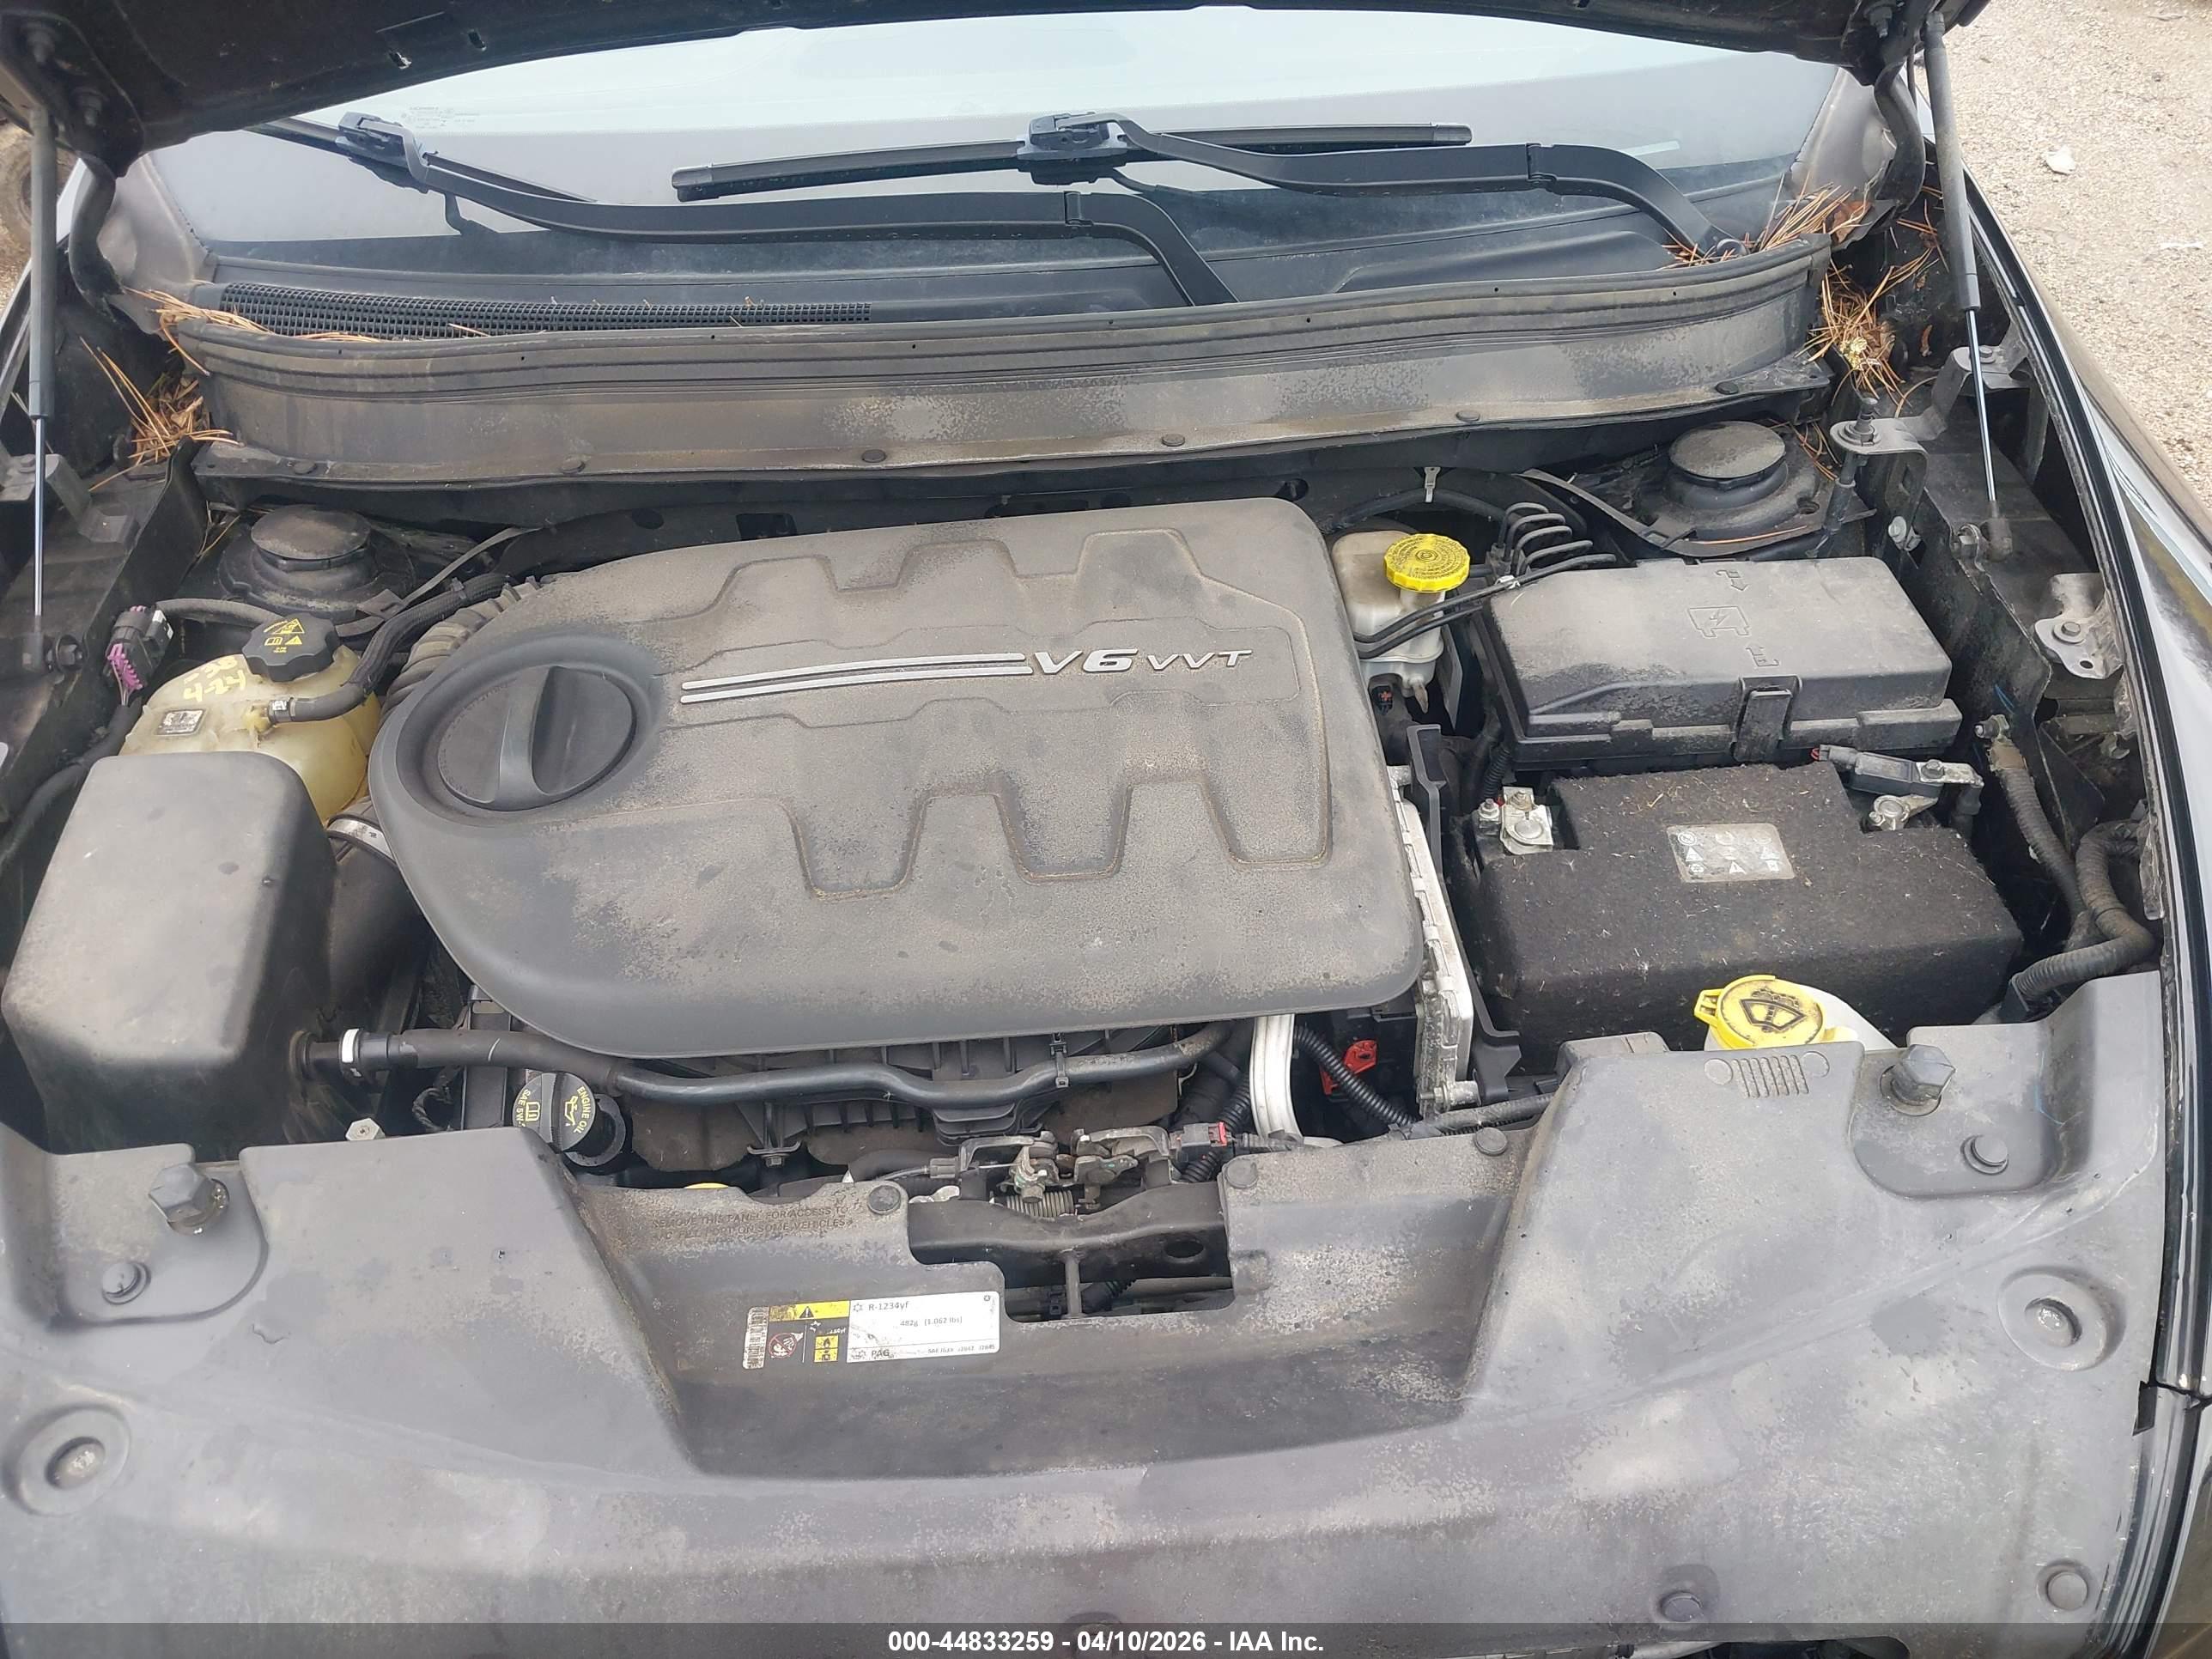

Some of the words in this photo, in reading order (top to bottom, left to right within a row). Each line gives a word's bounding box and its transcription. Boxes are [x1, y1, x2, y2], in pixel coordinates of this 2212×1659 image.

[1034, 648, 1138, 675] V6
[1147, 650, 1253, 671] VVT
[518, 1089, 531, 1106] SAE
[576, 1086, 592, 1119] ENGINE
[573, 1121, 587, 1133] OIL
[727, 1211, 763, 1222] PANEL
[765, 1209, 787, 1219] FOR
[789, 1206, 832, 1218] ACCESS
[835, 1205, 849, 1214] TO
[738, 1223, 757, 1234] ON
[757, 1222, 789, 1233] SOME
[868, 1300, 909, 1311] R-1234yf
[871, 1348, 890, 1358] PAG
